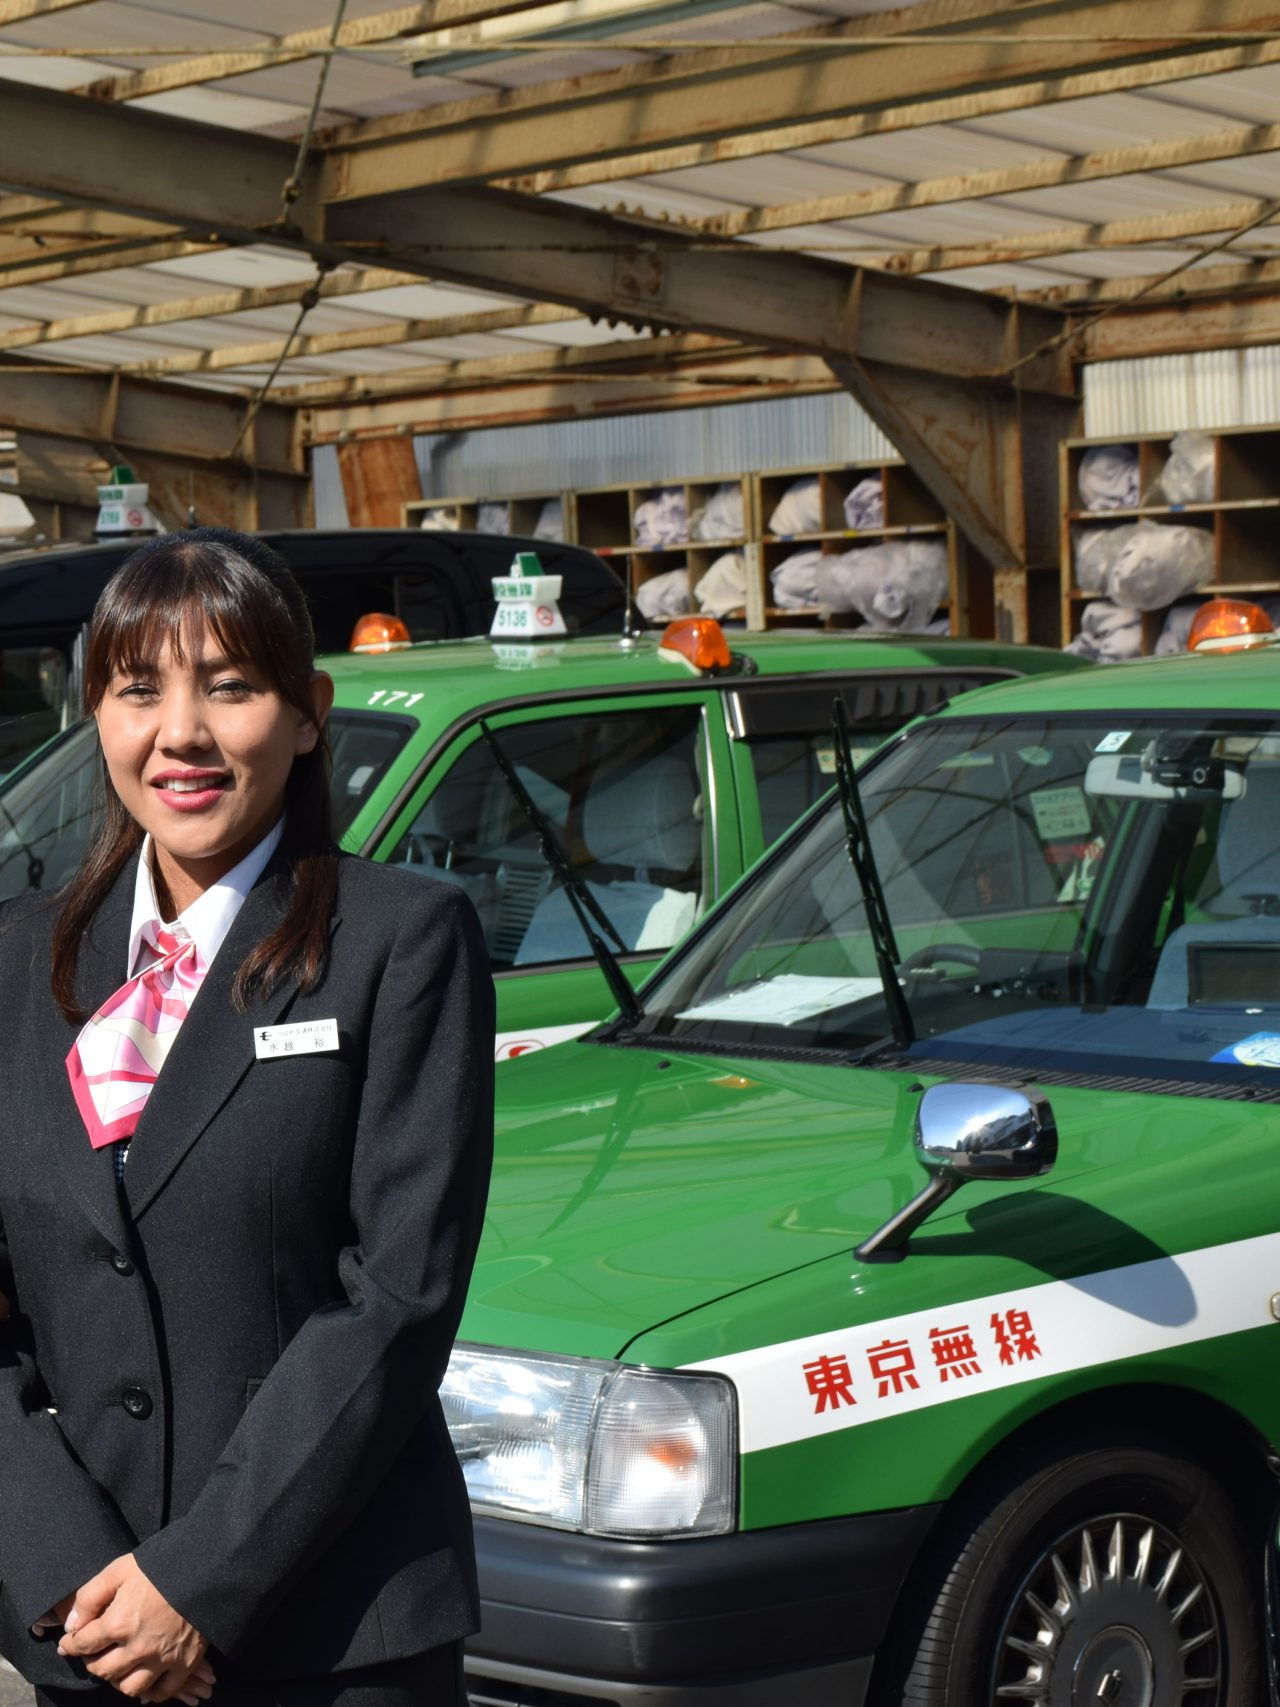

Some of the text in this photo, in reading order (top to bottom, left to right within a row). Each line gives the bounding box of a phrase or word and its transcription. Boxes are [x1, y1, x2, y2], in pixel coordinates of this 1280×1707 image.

[499, 610, 527, 628] 5136
[367, 690, 424, 708] 171
[802, 1308, 1042, 1415] 東京無線
